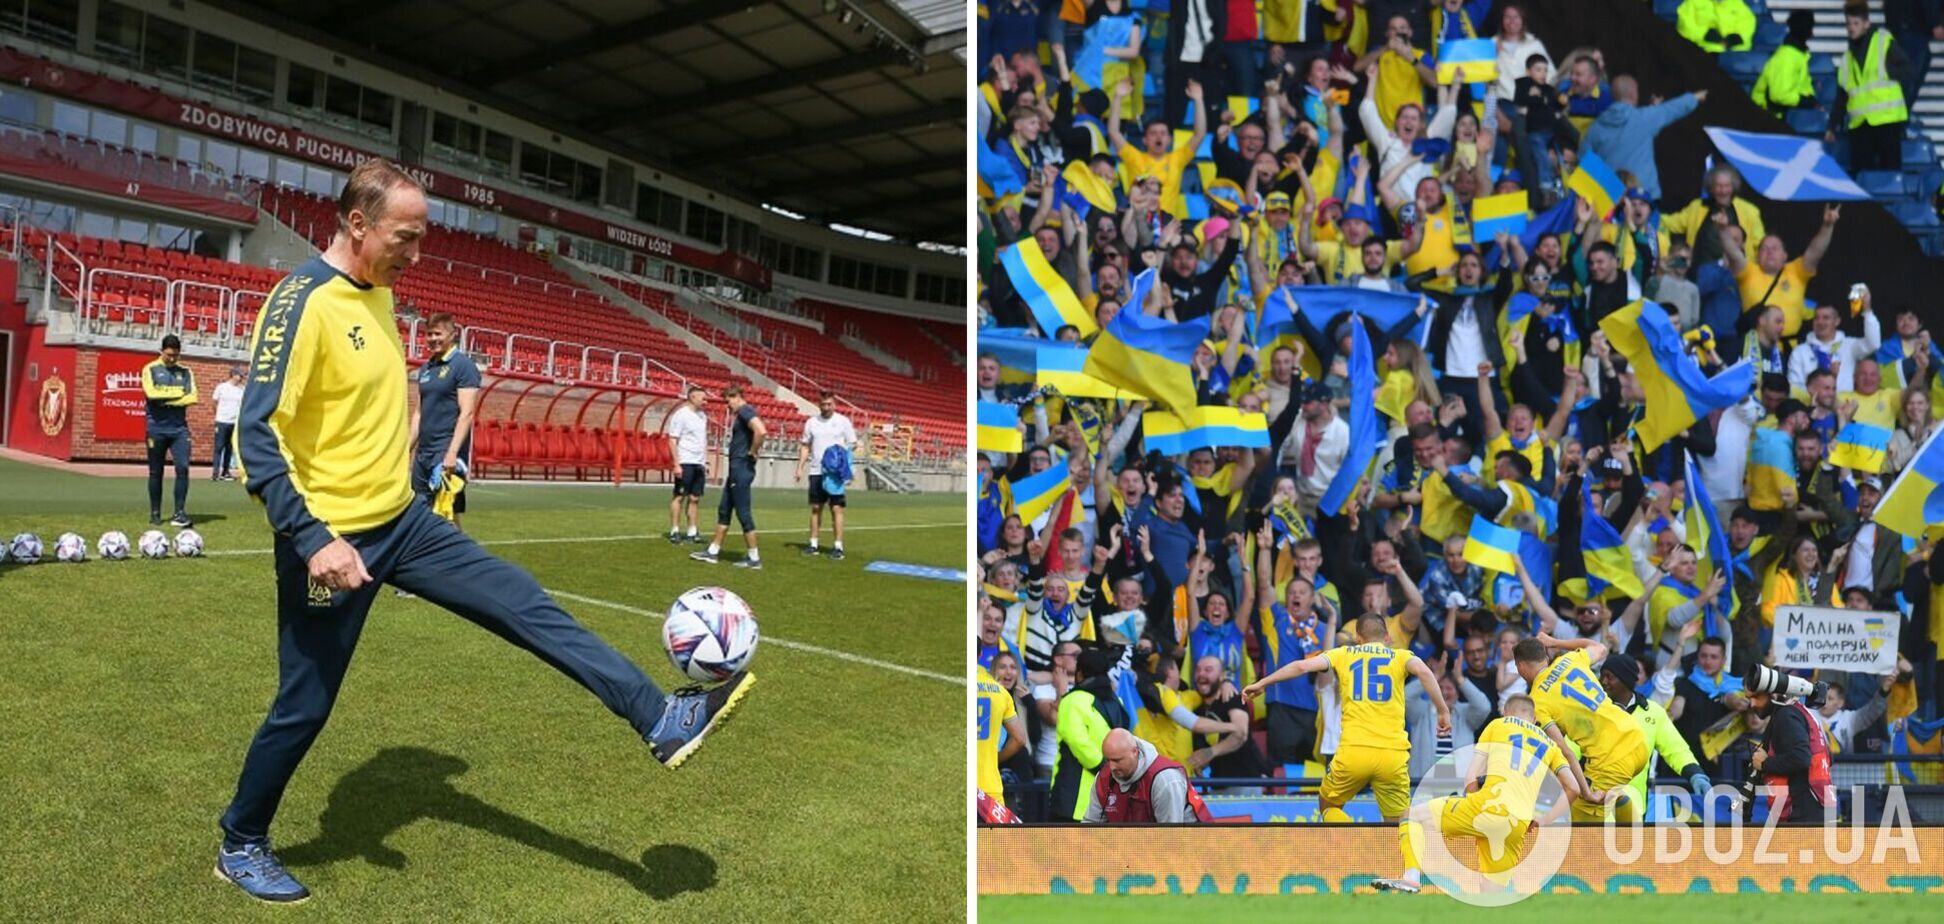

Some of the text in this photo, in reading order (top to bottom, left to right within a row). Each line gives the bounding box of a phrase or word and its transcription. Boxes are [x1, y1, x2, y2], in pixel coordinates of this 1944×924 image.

[180, 104, 289, 149] ZDOBYWCA
[296, 136, 371, 169] PUCHAR
[463, 184, 495, 205] 1985
[126, 182, 140, 196] A7
[607, 225, 647, 248] WIDZEW
[255, 275, 314, 383] UKRAINE
[1350, 656, 1393, 702] 16
[1561, 667, 1606, 712] 13
[1508, 733, 1549, 778] 17
